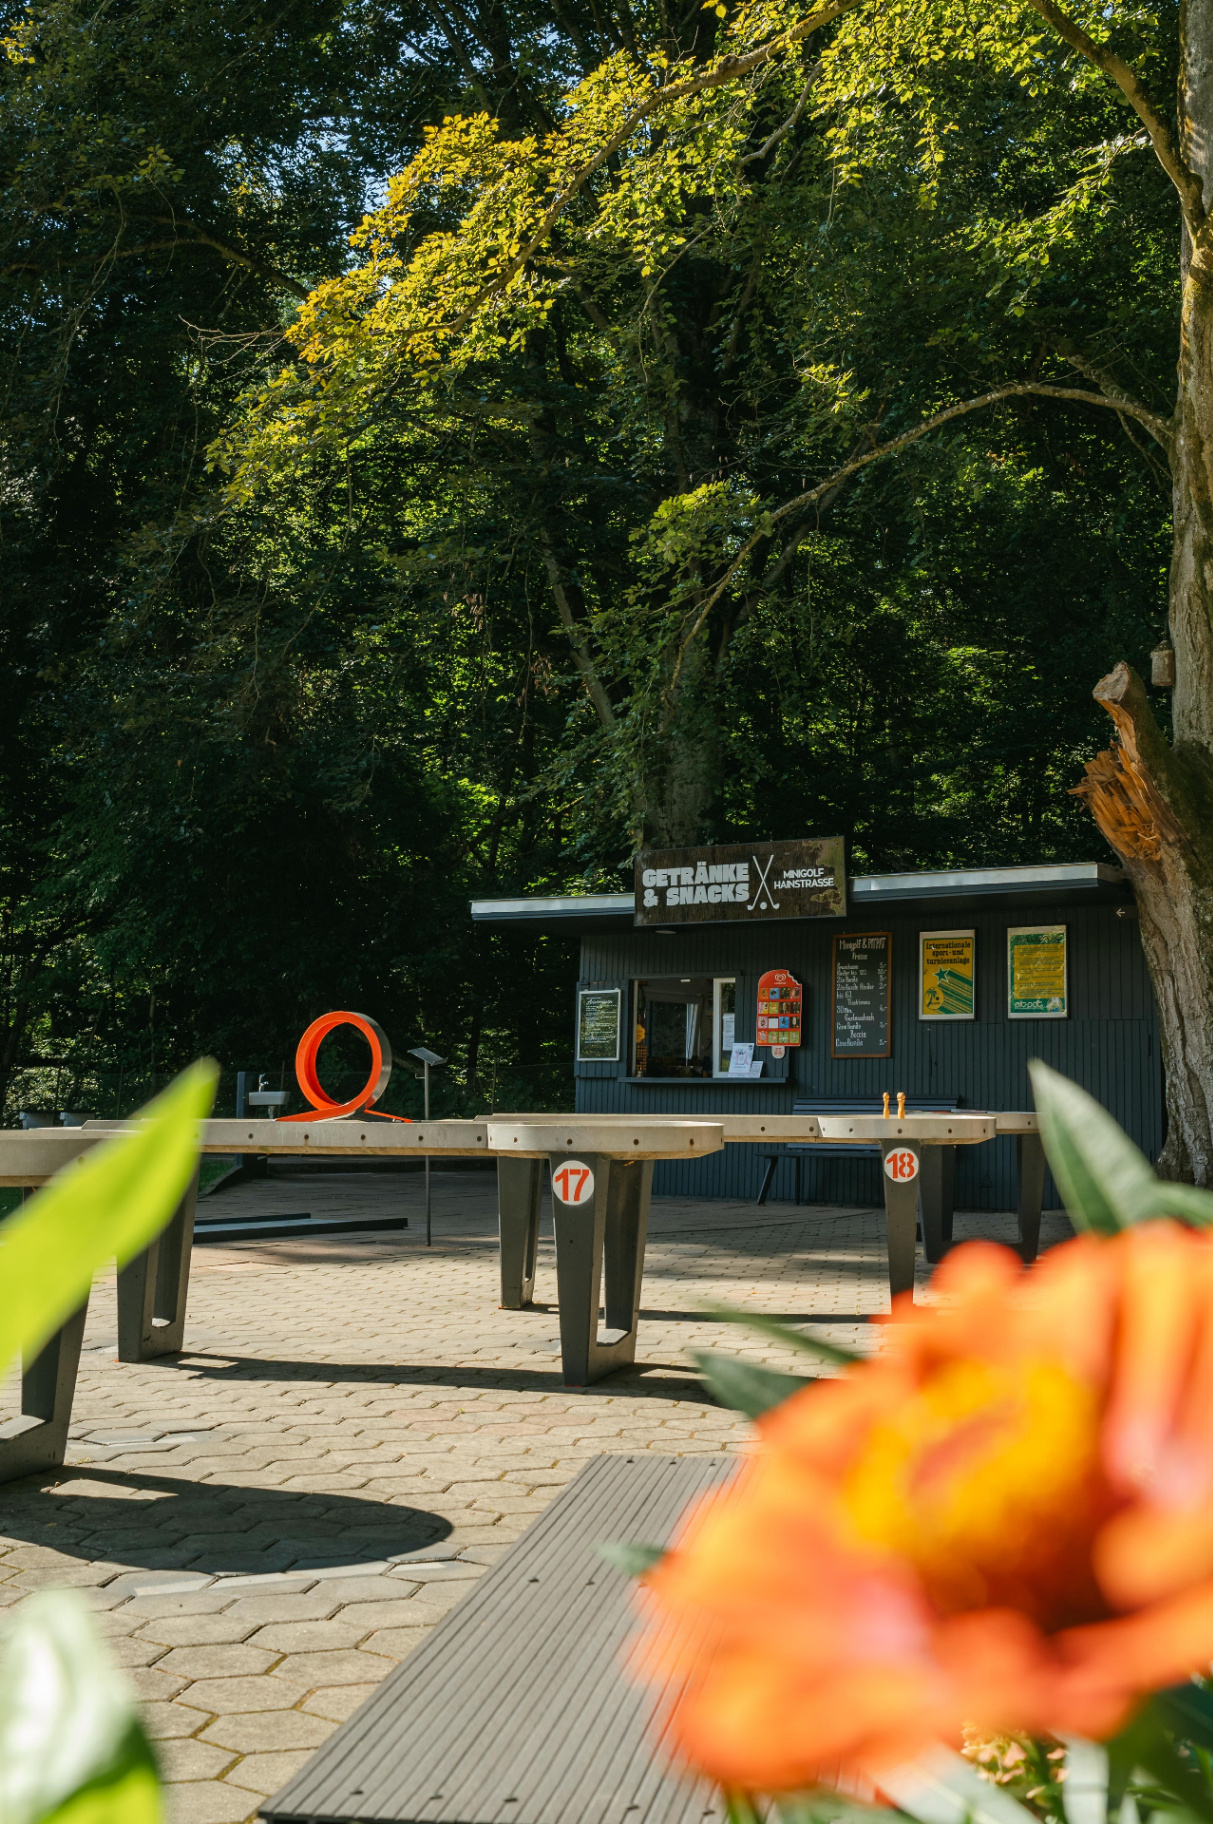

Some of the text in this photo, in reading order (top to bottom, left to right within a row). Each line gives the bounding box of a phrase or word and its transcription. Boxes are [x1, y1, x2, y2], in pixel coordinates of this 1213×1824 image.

[642, 861, 749, 887] GETRÄNKE
[783, 868, 825, 879] MINIGOLF
[773, 877, 835, 889] HAINSTRASSE
[643, 883, 749, 907] & SNACKS
[926, 941, 971, 950] internationale
[926, 957, 970, 965] turnieranlage
[886, 1152, 915, 1178] 18
[554, 1169, 590, 1202] 17
